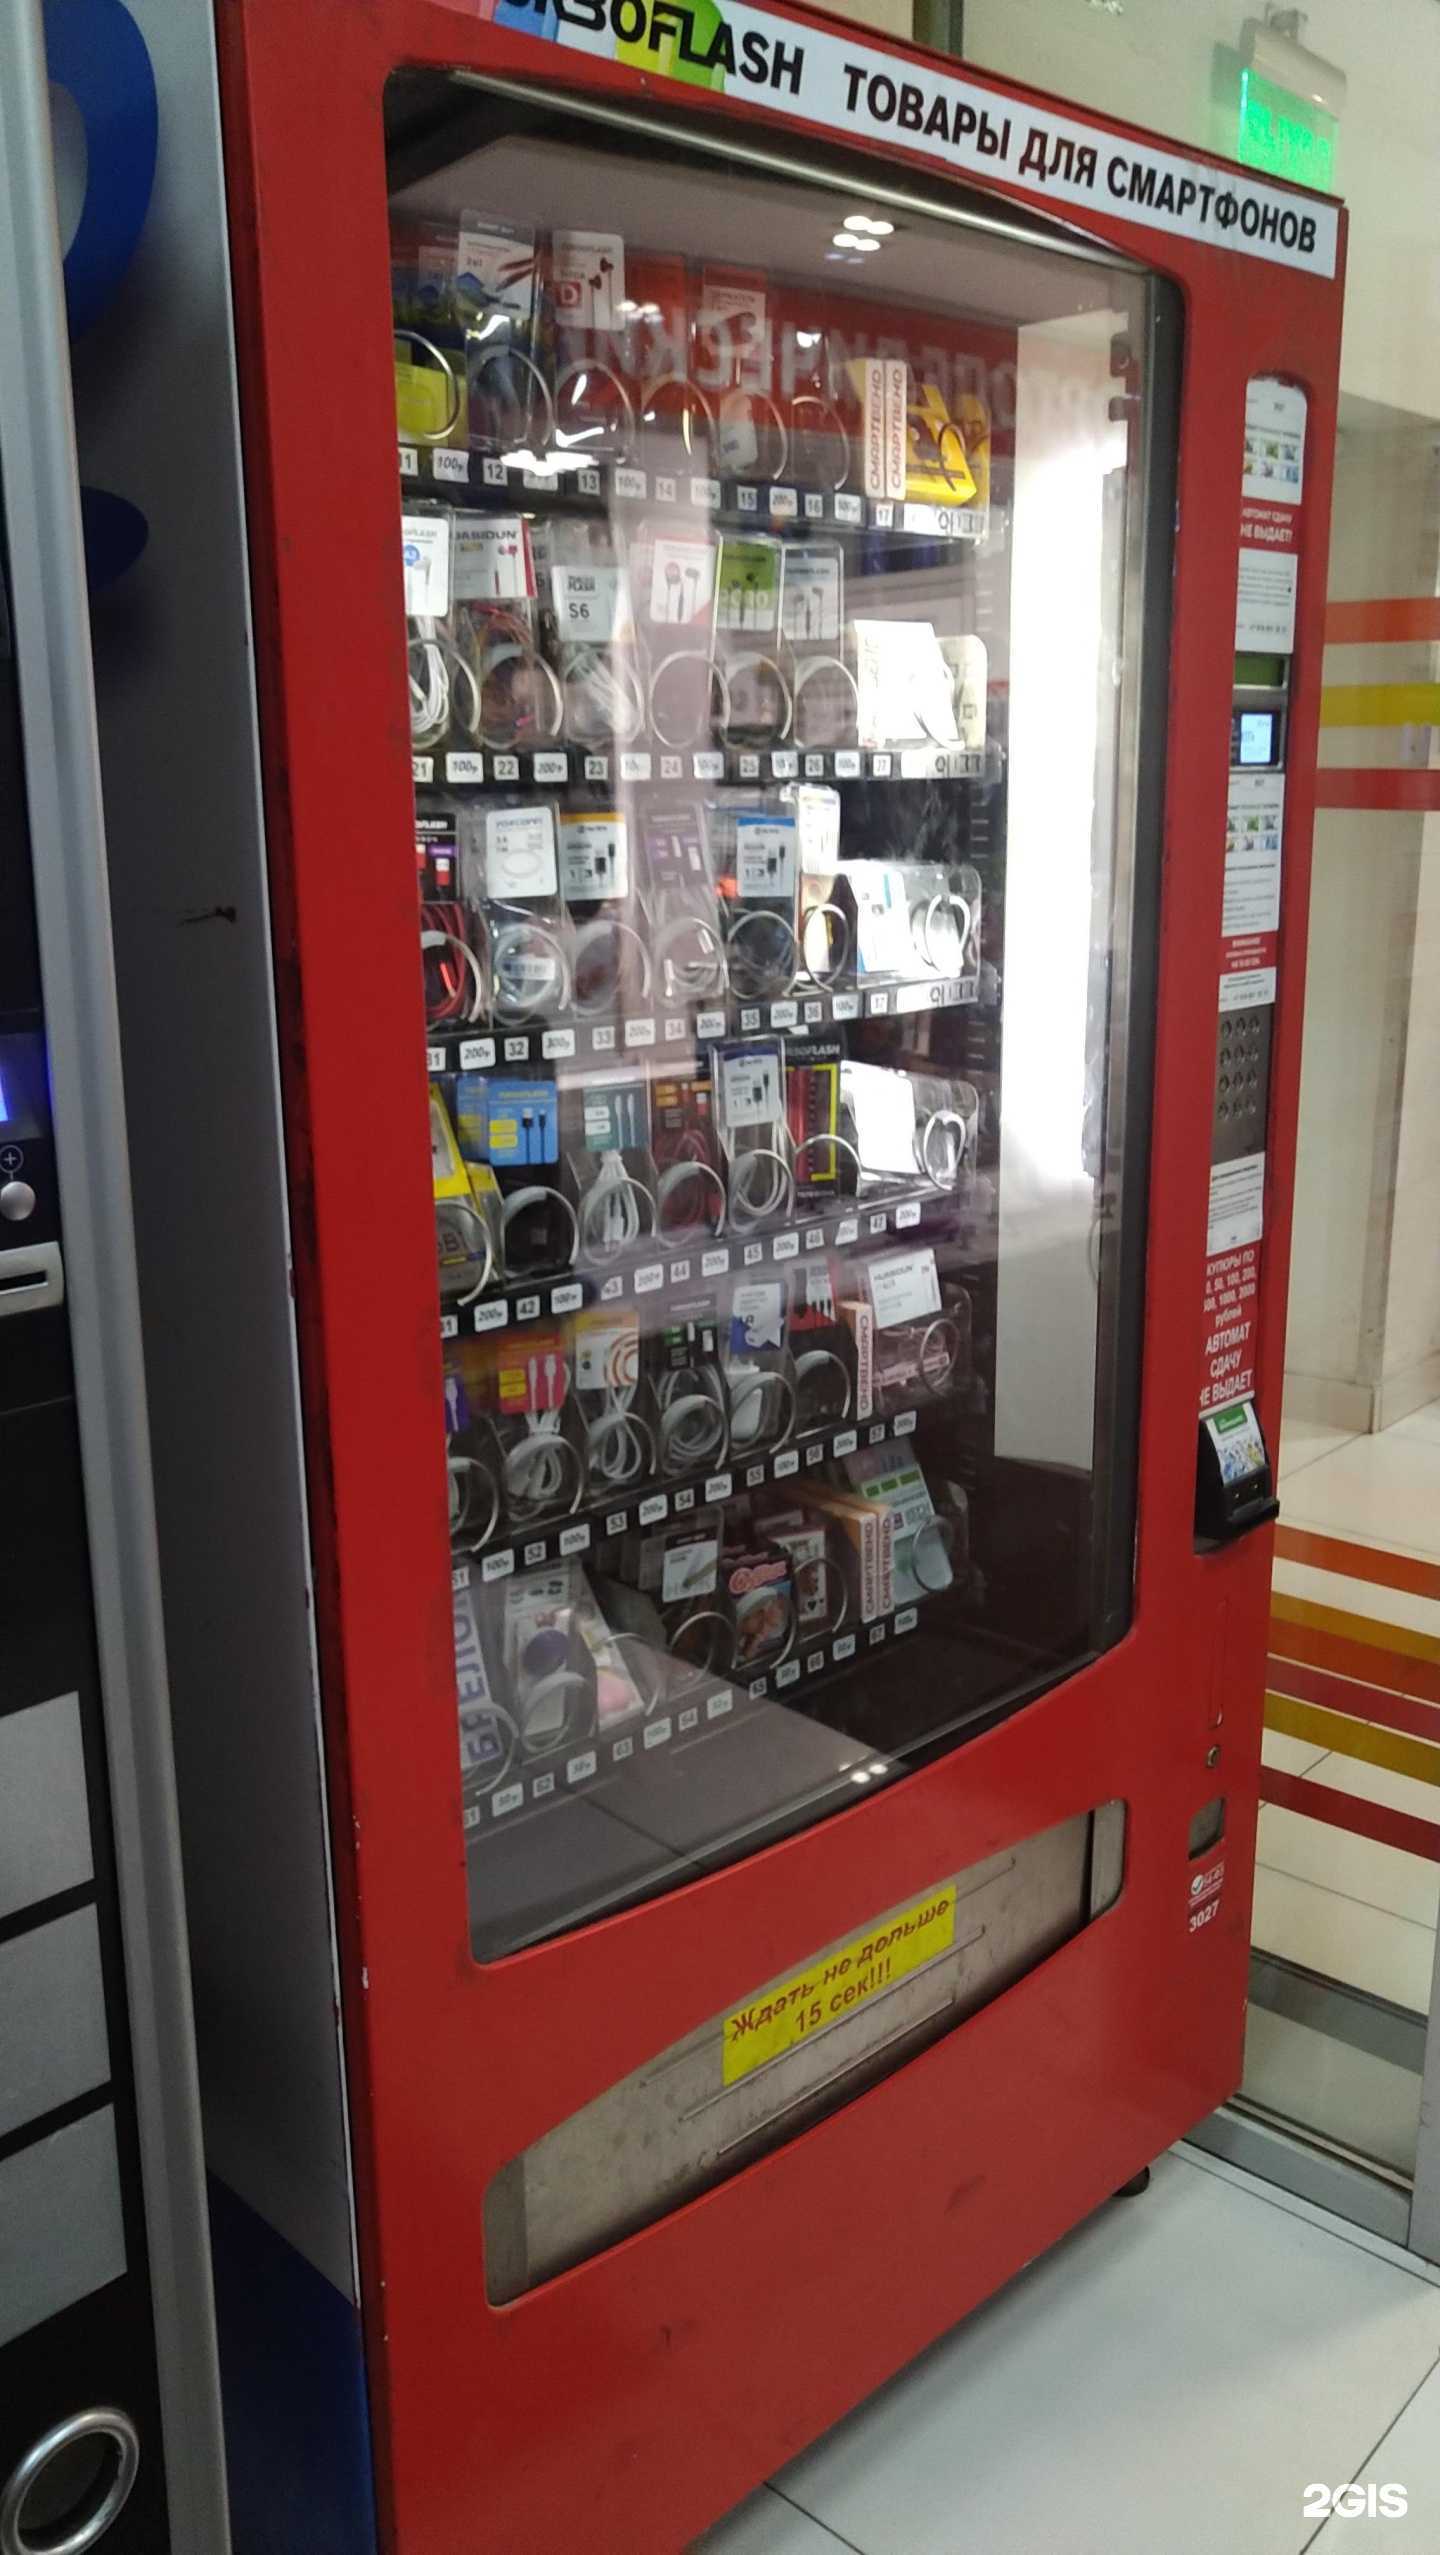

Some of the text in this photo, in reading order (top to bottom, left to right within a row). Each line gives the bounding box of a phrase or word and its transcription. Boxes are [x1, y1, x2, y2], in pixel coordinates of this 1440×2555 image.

[504, 0, 804, 96] BOFLASH
[843, 64, 1317, 254] ТОВАРЫ ДЛЯ СМАРТФОНОВ
[437, 456, 463, 472] 100р
[486, 463, 505, 480] 12
[581, 474, 597, 490] 13
[1240, 523, 1253, 538] НЕ
[569, 602, 590, 619] S6
[452, 759, 479, 775] 100р
[498, 760, 515, 776] 22
[588, 759, 604, 775] 23
[509, 1041, 525, 1057] 32
[1243, 1250, 1255, 1265] ПО
[672, 1264, 687, 1278] 44
[519, 1300, 536, 1315] 42
[1215, 1303, 1242, 1329] рублей
[1204, 1321, 1252, 1357] АВТОМАТ
[1210, 1350, 1242, 1379] СДАЧУ
[1212, 1368, 1253, 1401] ВЫДАЕТ
[609, 1514, 625, 1530] 53
[527, 1544, 543, 1561] 52
[1189, 1899, 1220, 1933] 3027
[731, 1899, 949, 2041] Ждать не дольше
[795, 1957, 892, 2033] 15 сек!!!
